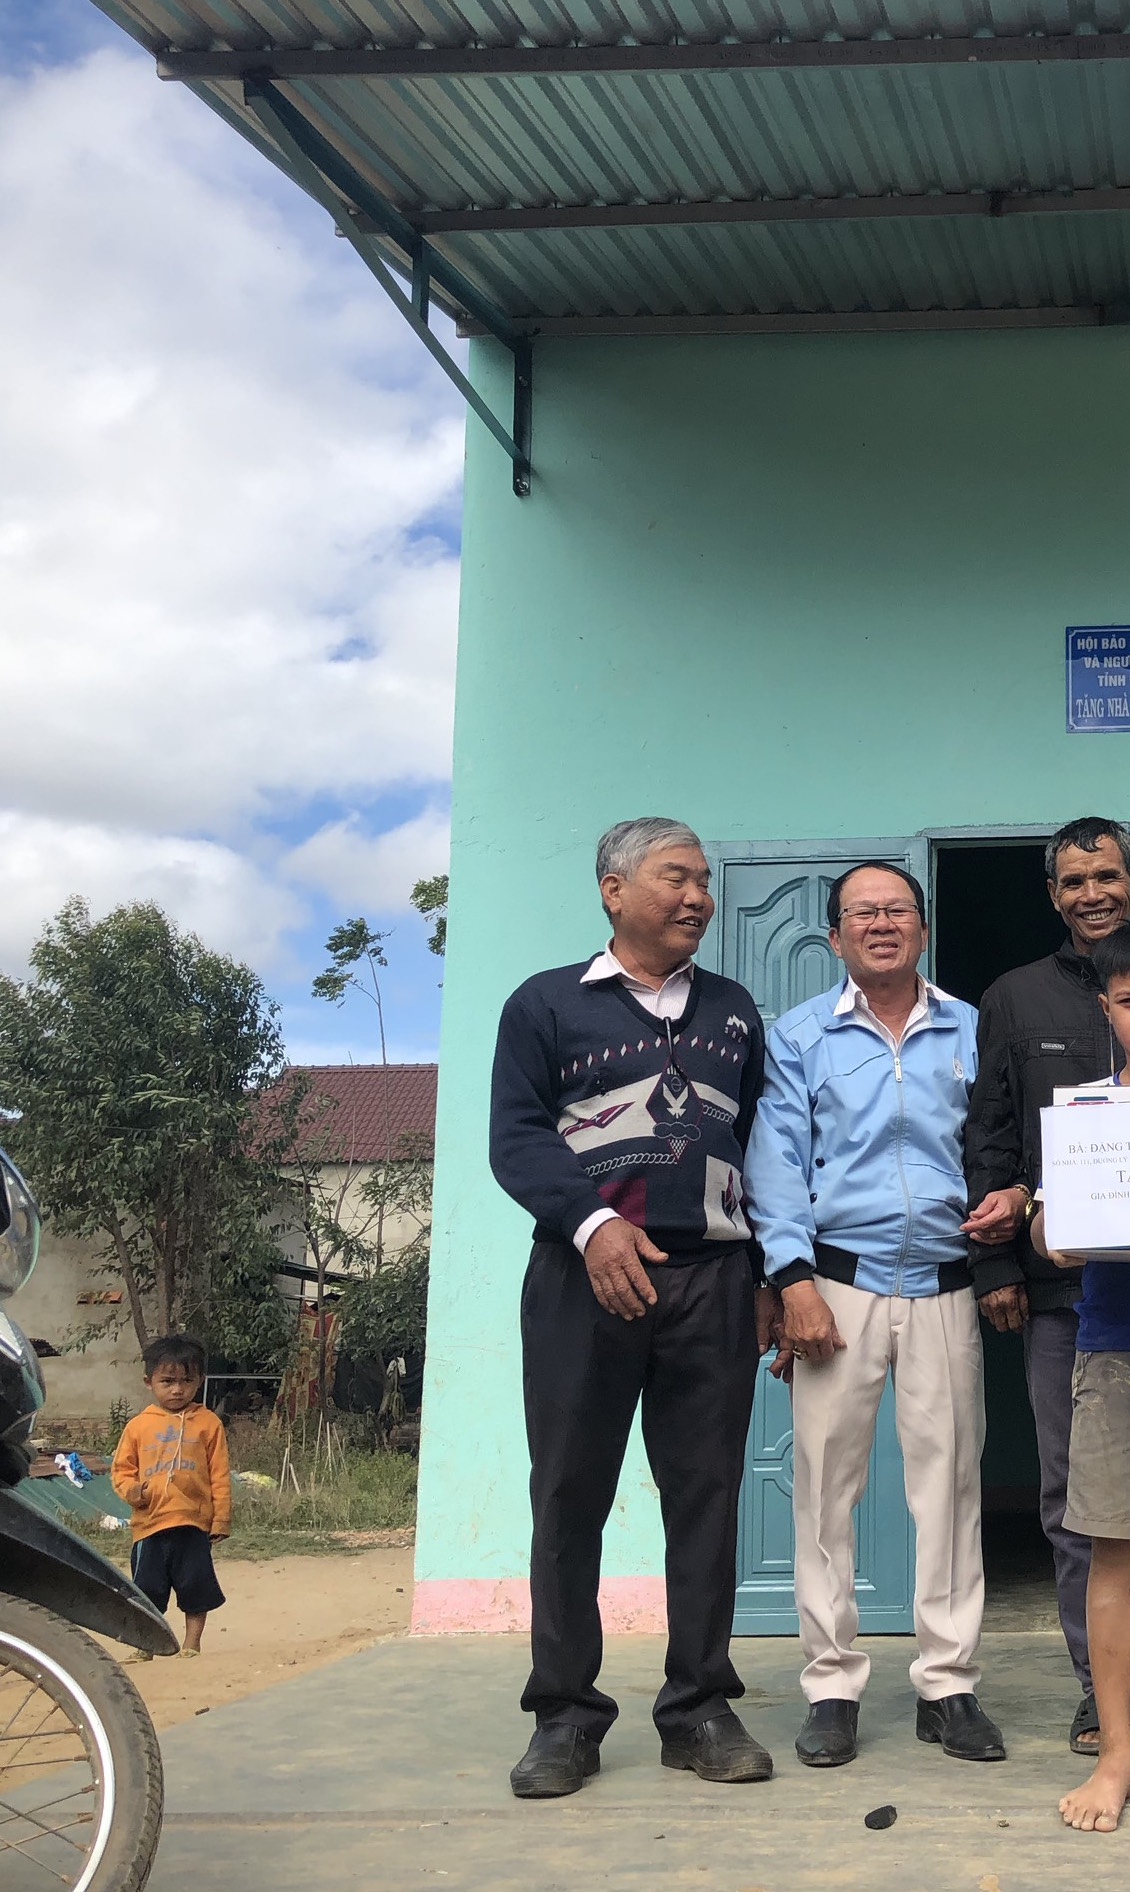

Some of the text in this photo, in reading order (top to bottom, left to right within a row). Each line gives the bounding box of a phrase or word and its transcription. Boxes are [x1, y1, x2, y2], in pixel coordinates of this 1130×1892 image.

[1077, 636, 1098, 652] HỘI
[1101, 634, 1127, 650] BẢO
[1084, 655, 1100, 669] VÀ
[1076, 693, 1105, 723] TẶNG
[1107, 692, 1130, 717] NHÀ
[1090, 1192, 1107, 1200] GIA
